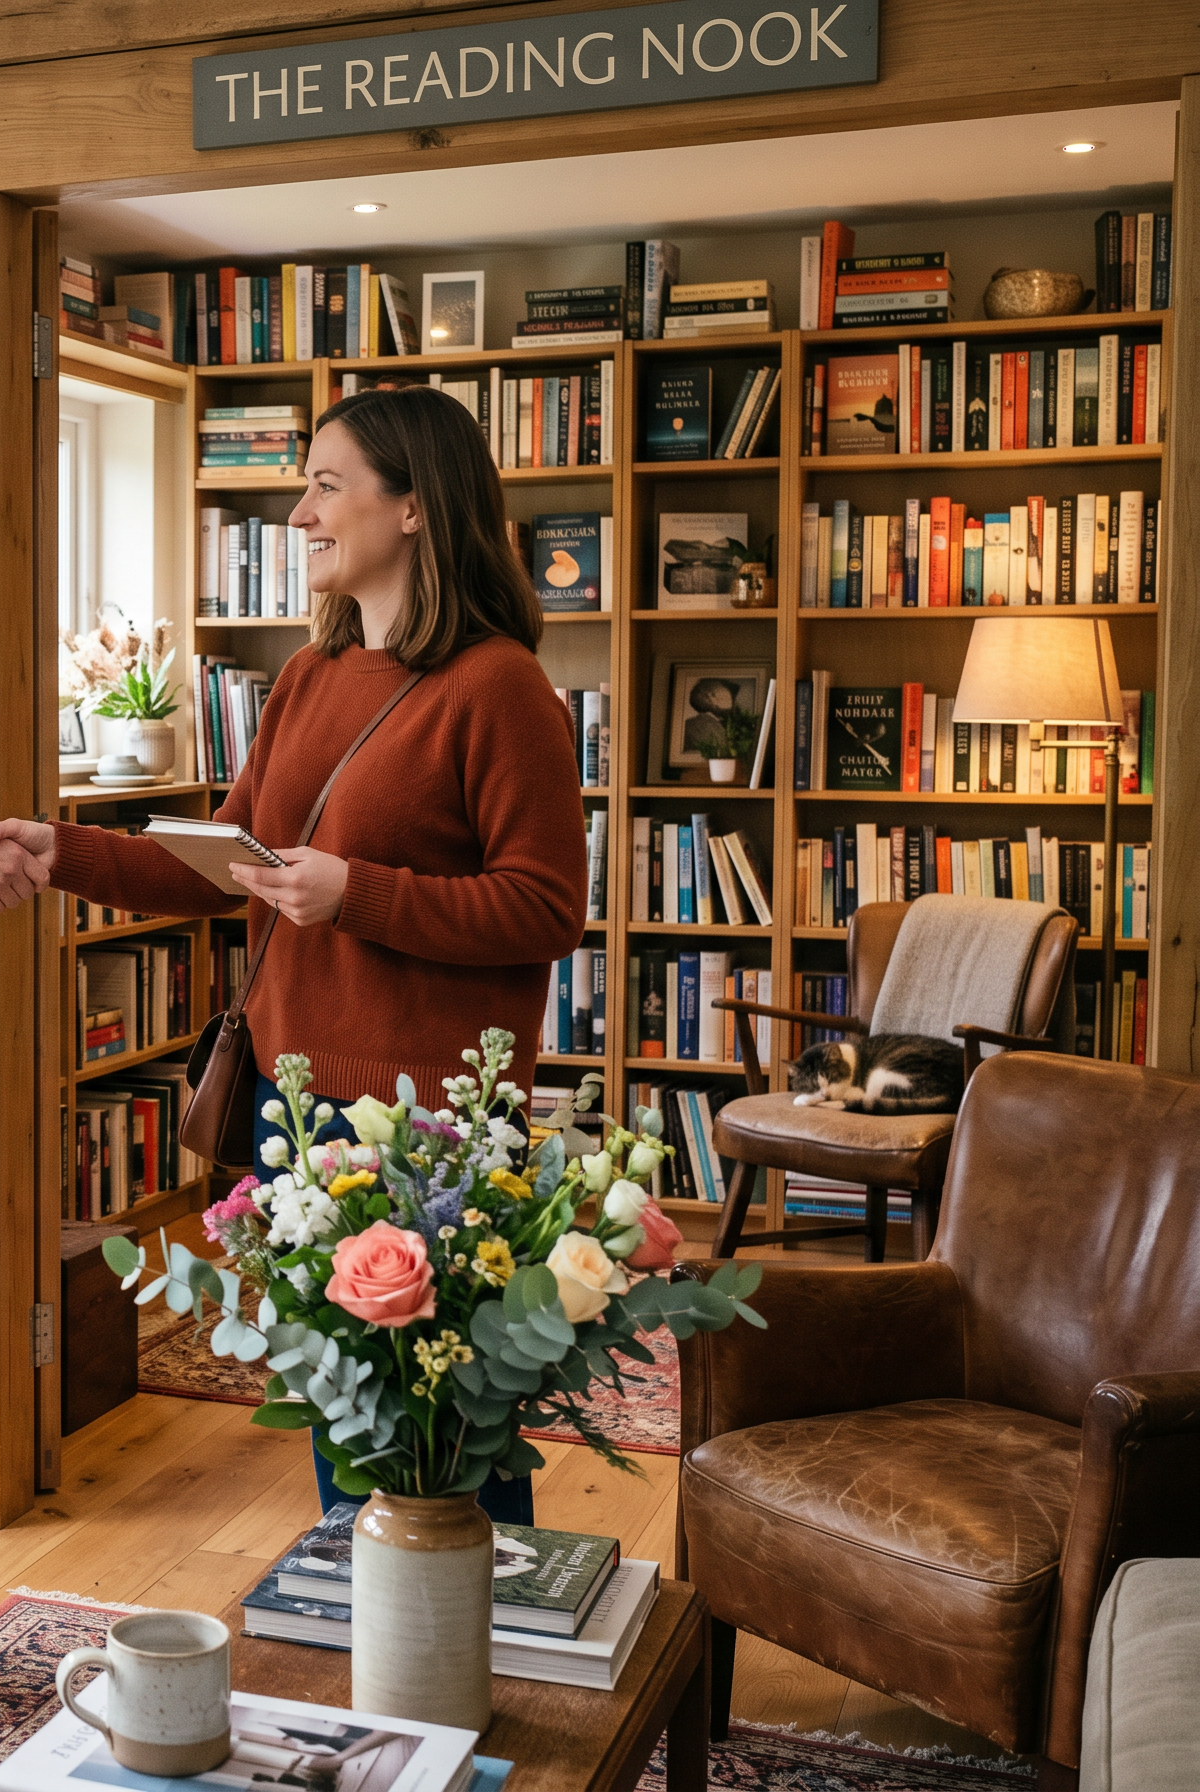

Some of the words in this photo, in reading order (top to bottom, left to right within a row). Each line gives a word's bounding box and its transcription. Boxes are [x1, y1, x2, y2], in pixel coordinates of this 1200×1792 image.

[215, 64, 324, 123] THE
[344, 32, 615, 111] READING
[641, 4, 849, 79] NOOK
